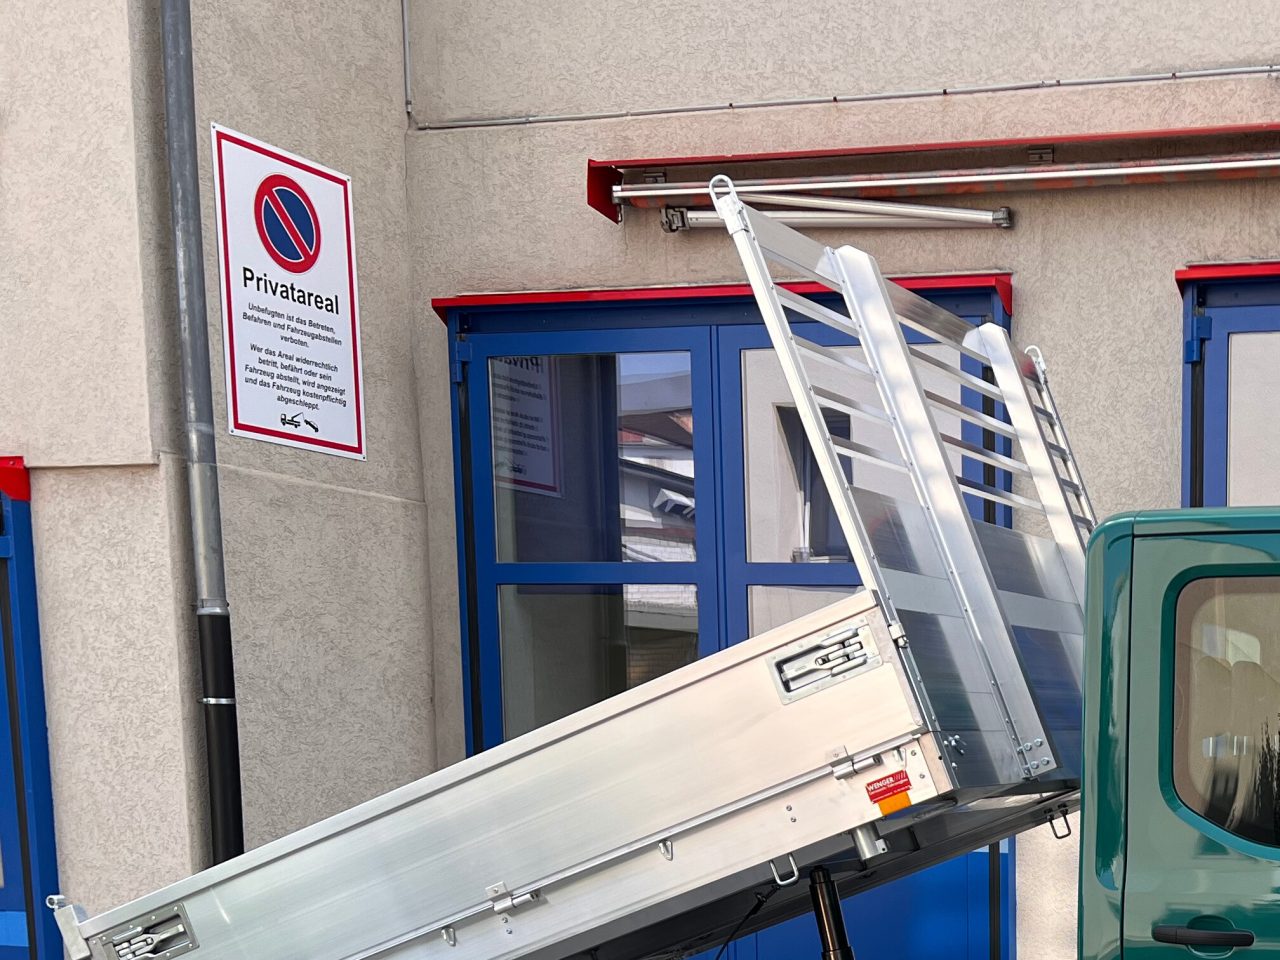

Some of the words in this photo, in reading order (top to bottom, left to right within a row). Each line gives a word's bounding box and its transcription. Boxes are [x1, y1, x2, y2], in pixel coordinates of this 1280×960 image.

[242, 266, 340, 315] Privatareal
[242, 312, 272, 326] Befahren
[273, 322, 285, 330] und
[286, 324, 342, 346] Fahrzeugabstellen
[248, 302, 285, 319] Unbefugten
[286, 314, 294, 322] ist
[295, 316, 307, 325] das
[308, 320, 335, 334] Betreten,
[280, 334, 309, 348] verboten.
[250, 343, 263, 352] Wer
[265, 347, 276, 356] das
[277, 351, 294, 361] Areal
[295, 355, 338, 372] widerrechtlich
[258, 357, 278, 369] betritt,
[280, 362, 303, 374] befährt
[304, 368, 318, 377] oder
[319, 372, 332, 381] sein
[244, 364, 275, 379] Fahrzeug
[276, 372, 300, 385] abstellt,
[302, 378, 316, 387] wird
[317, 383, 346, 395] angezeigt
[244, 376, 257, 385] und
[259, 379, 271, 388] das
[272, 382, 301, 396] Fahrzeug
[302, 388, 347, 407] kostenpflichtig
[277, 395, 320, 410] abgeschleppt.
[866, 777, 895, 792] WENGER
